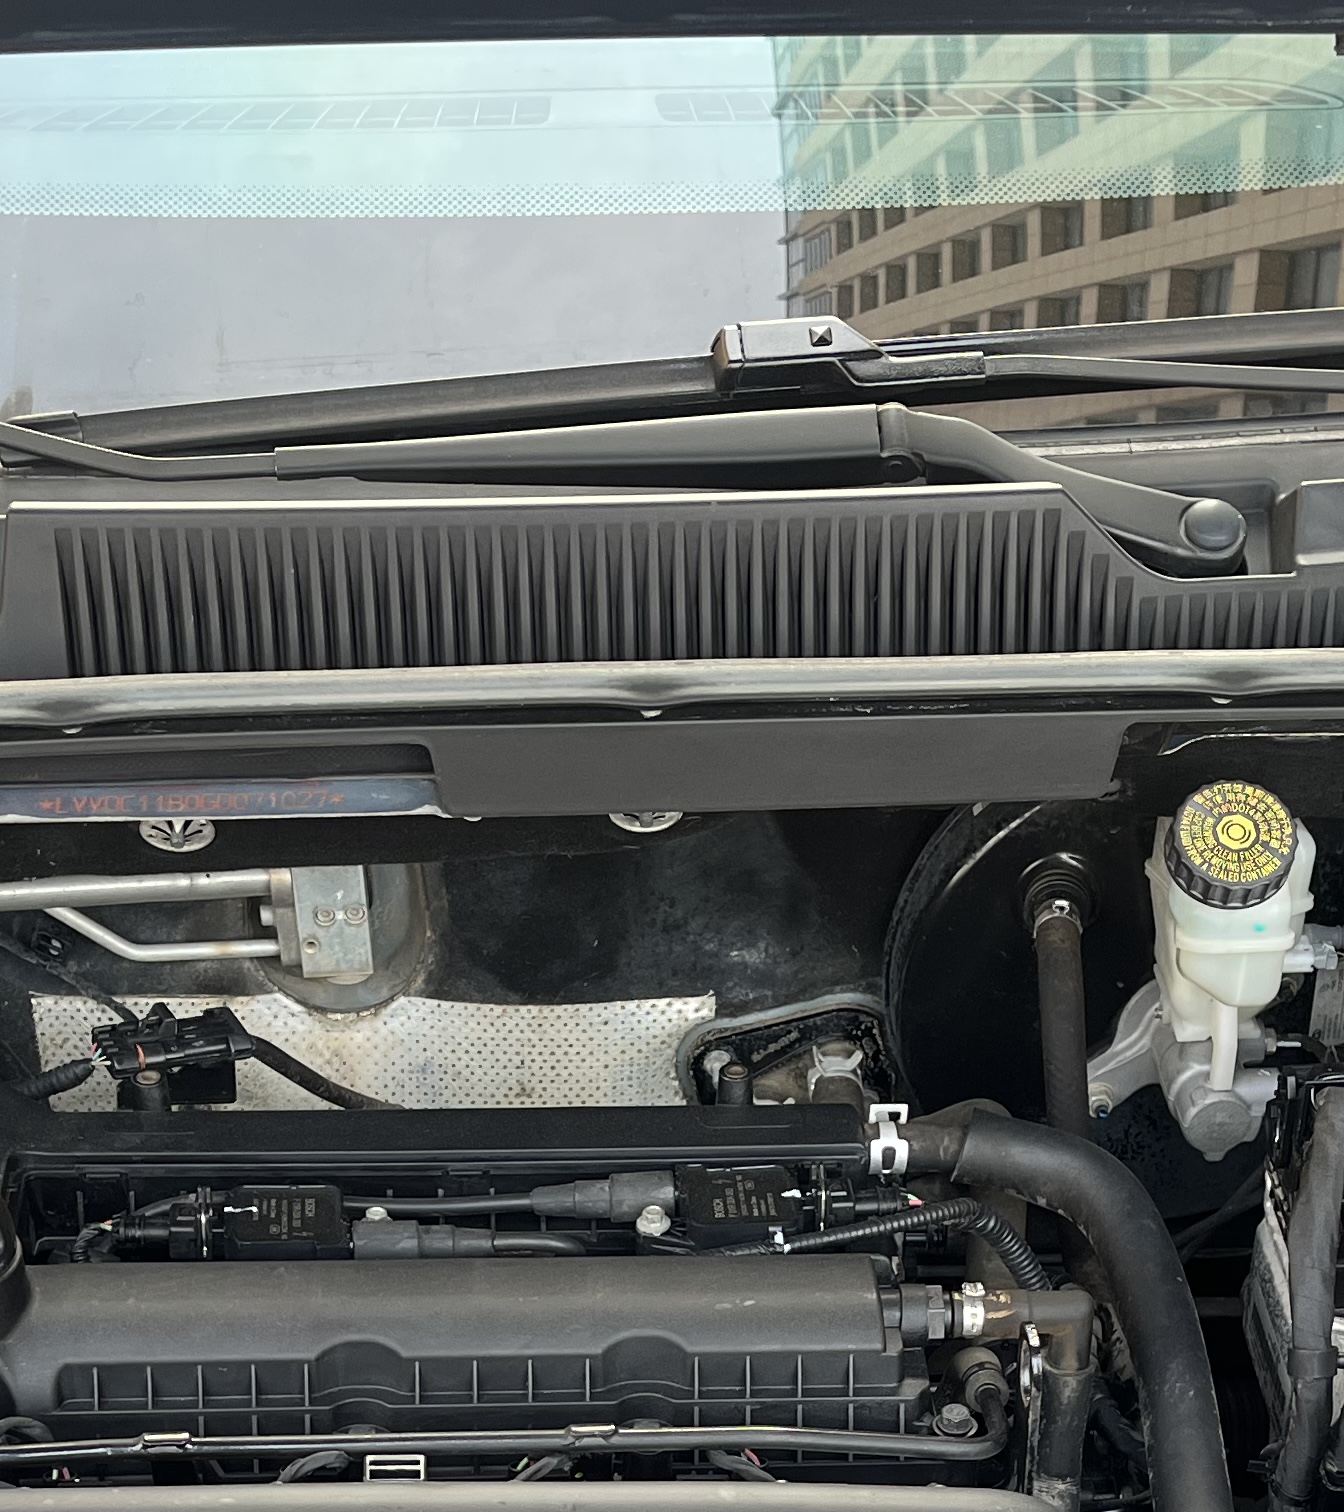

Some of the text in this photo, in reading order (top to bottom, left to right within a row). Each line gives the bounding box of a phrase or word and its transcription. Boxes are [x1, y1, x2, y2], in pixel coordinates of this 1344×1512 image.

[1186, 846, 1204, 866] FROM
[1208, 866, 1239, 882] SEALED
[1240, 857, 1282, 882] CONTAINER
[1214, 846, 1238, 861] CLEAN
